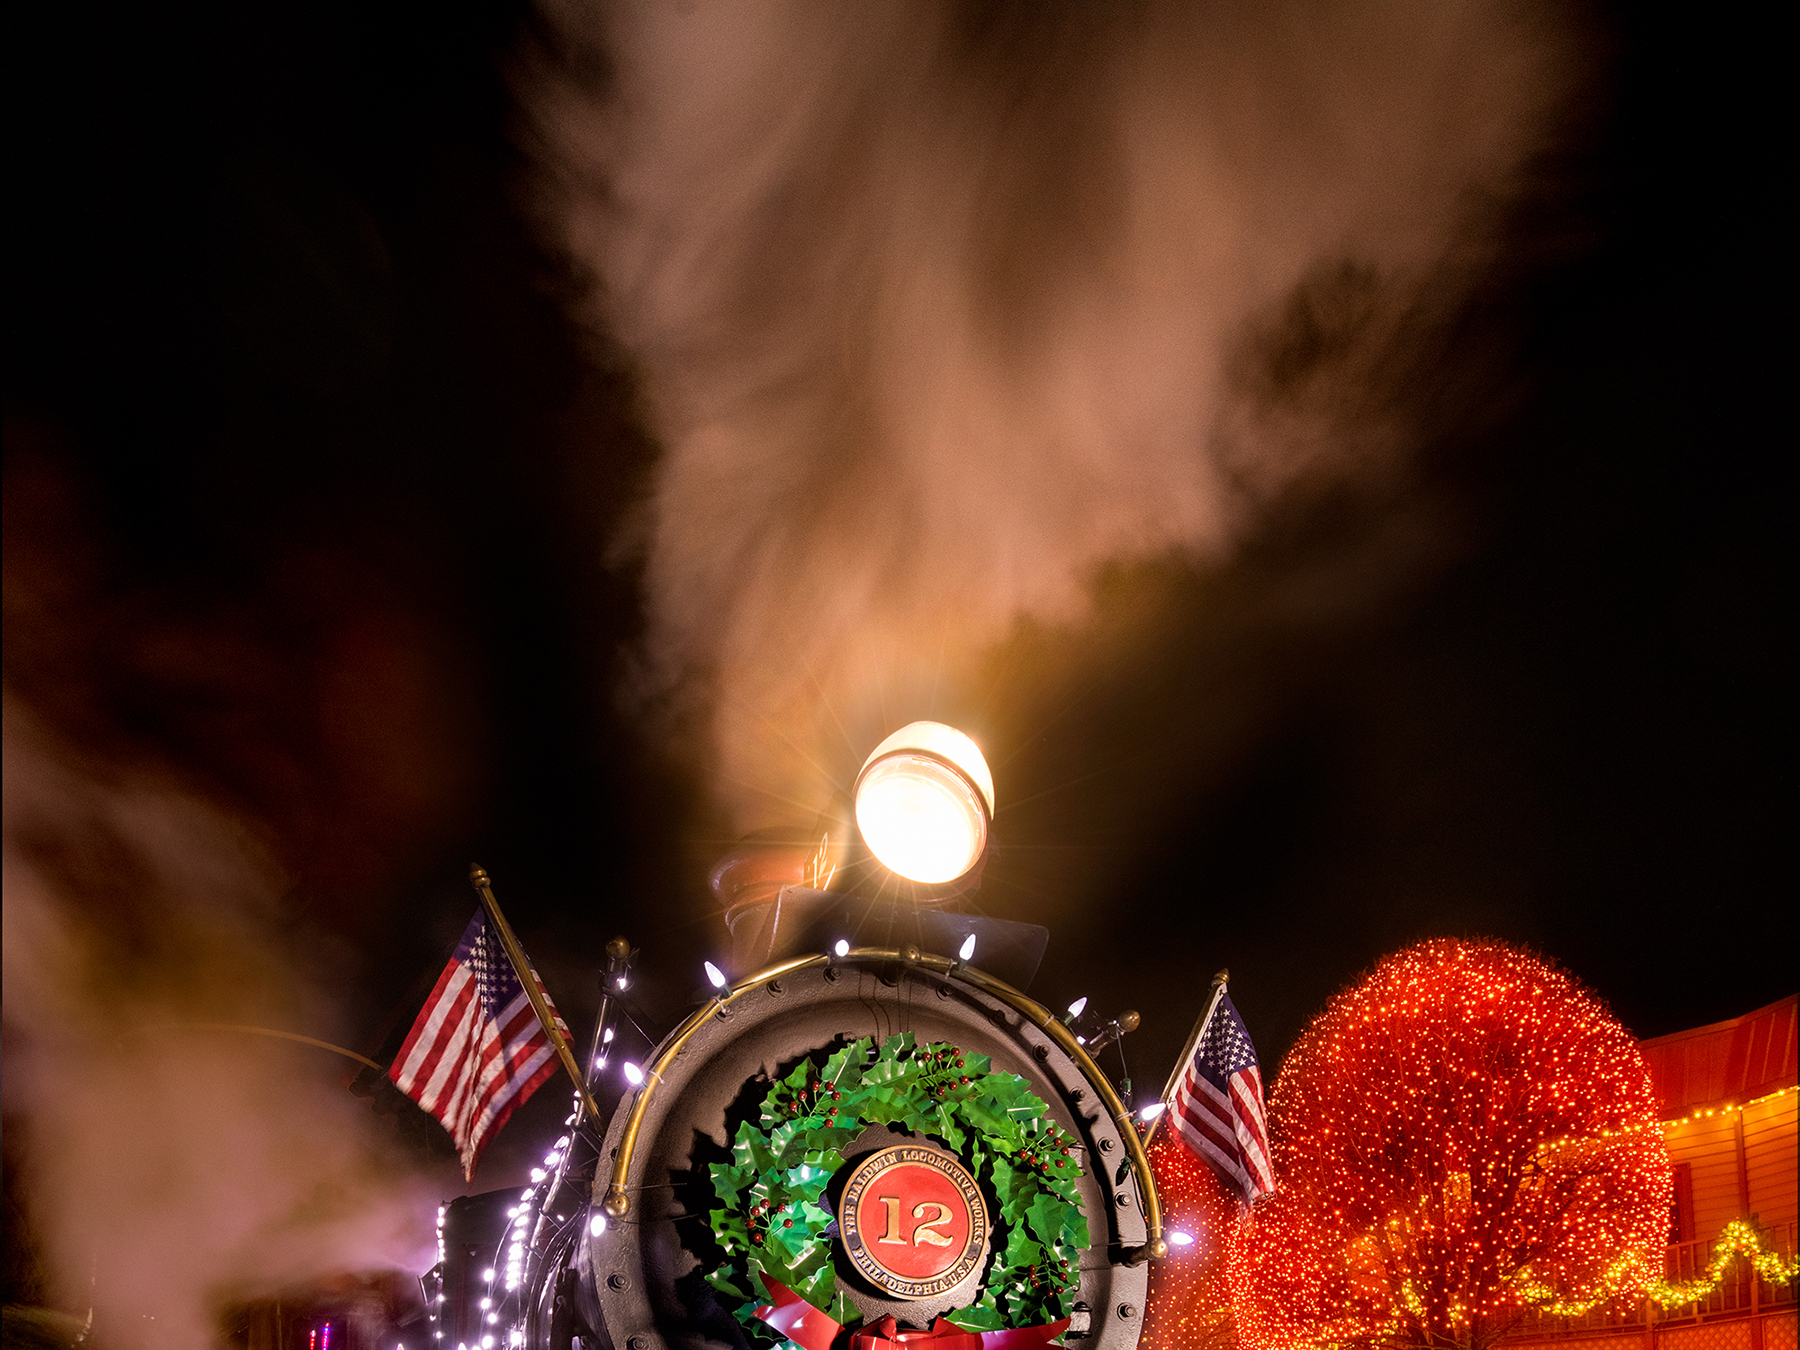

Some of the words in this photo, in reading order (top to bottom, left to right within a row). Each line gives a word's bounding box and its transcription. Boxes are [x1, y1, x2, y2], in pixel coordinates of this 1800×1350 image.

[848, 1151, 899, 1203] BALDWIN
[901, 1149, 975, 1197] LOCOMOTIVE
[843, 1203, 856, 1235] THE
[877, 1195, 954, 1248] 12
[969, 1196, 985, 1246] WORKS
